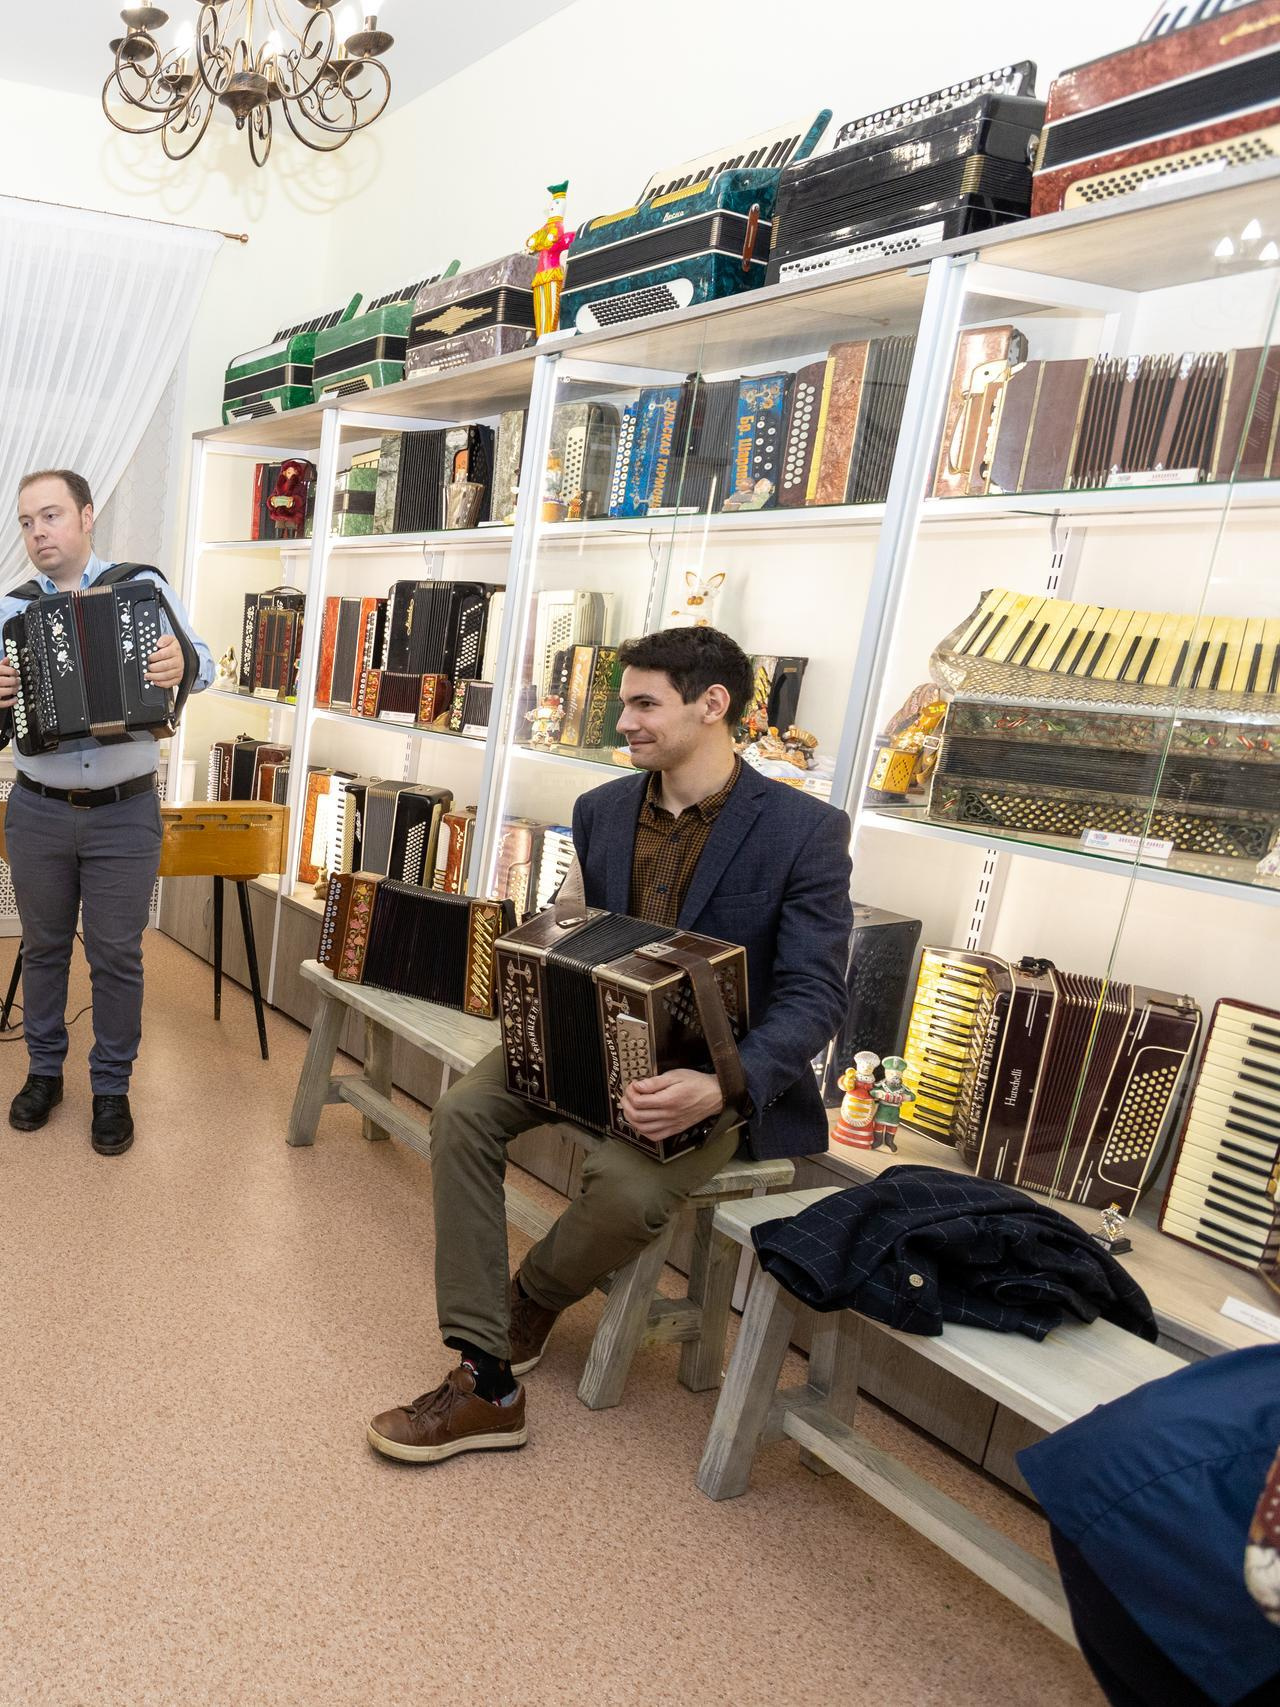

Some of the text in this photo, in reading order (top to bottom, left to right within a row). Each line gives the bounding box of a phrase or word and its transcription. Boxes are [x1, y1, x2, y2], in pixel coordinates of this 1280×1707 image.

[659, 400, 678, 455] ТУЛЬСКАЯ
[737, 415, 755, 436] Бр.
[527, 1014, 540, 1053] ФРАНЦЕВ
